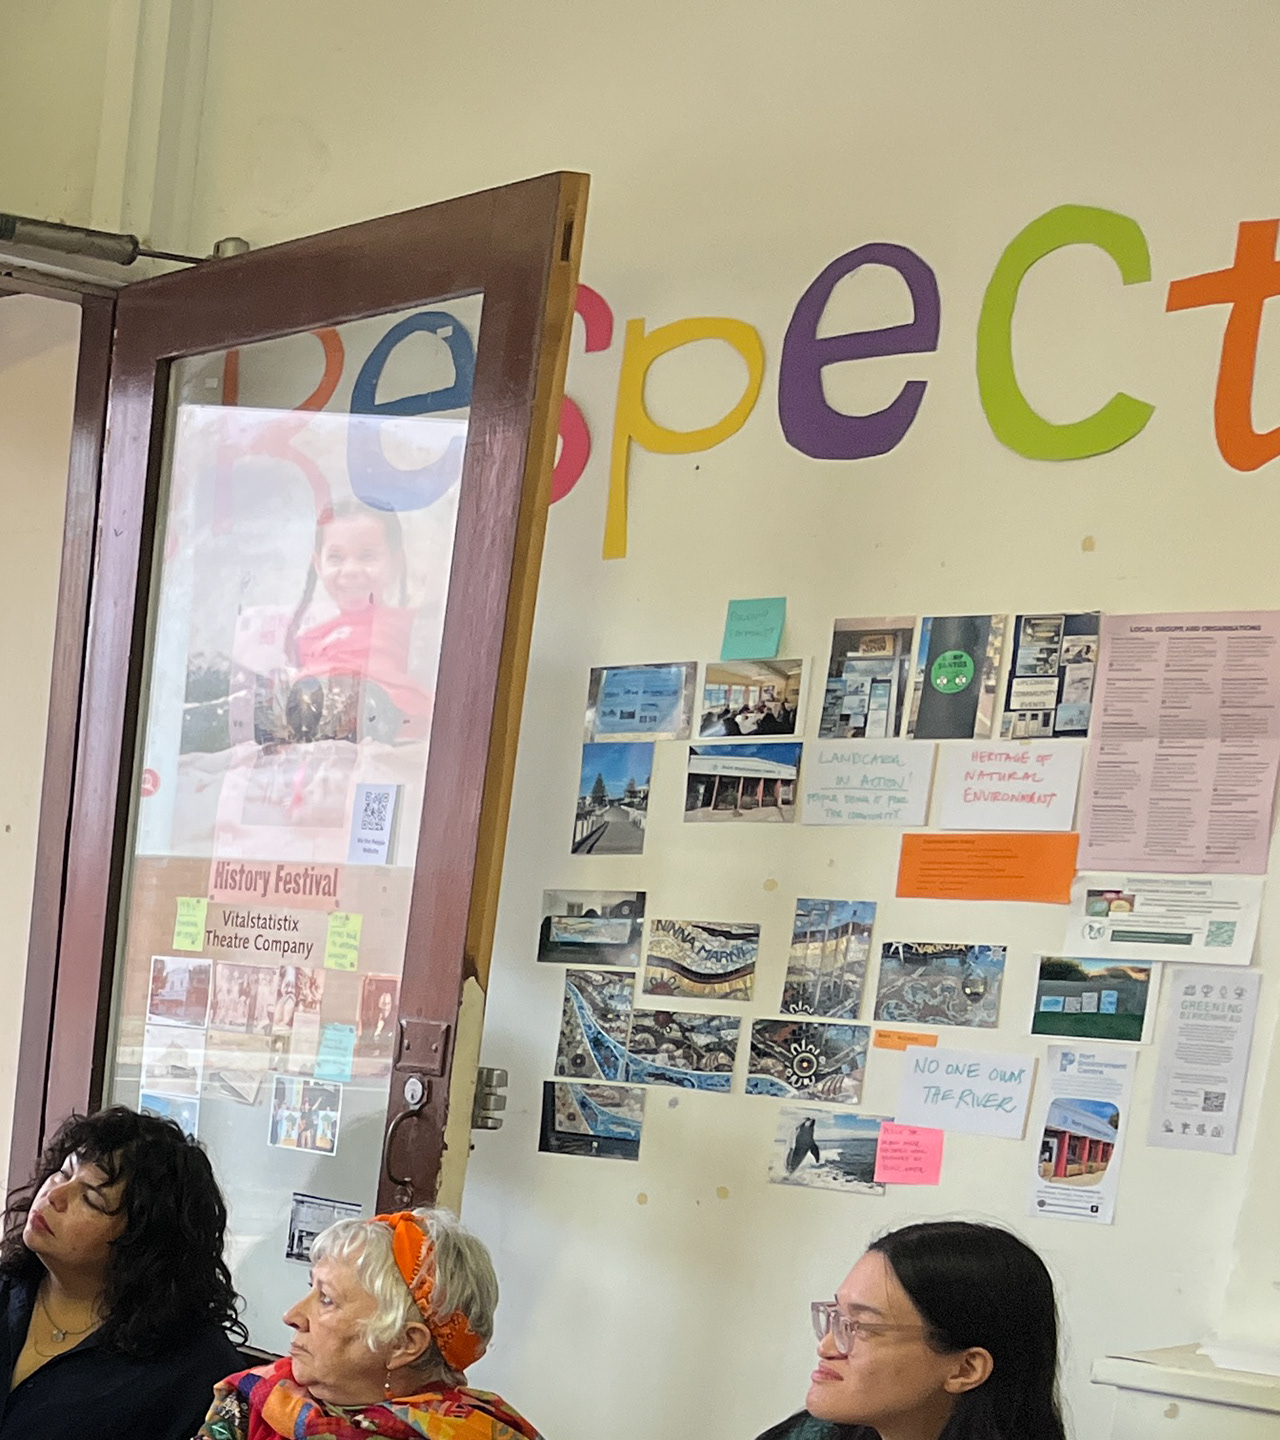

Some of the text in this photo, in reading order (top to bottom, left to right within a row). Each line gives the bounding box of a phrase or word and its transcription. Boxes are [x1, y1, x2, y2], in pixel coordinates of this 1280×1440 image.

[971, 751, 1053, 766] HERITAGE OF
[965, 770, 1044, 782] NATURAL
[214, 861, 339, 898] History Festival
[223, 910, 299, 932] Vitalstatistix
[206, 930, 249, 949] Theatre
[254, 934, 313, 960] Company
[914, 1057, 939, 1074] NO
[945, 1063, 980, 1078] ONE
[924, 1086, 1017, 1113] THE RIVER
